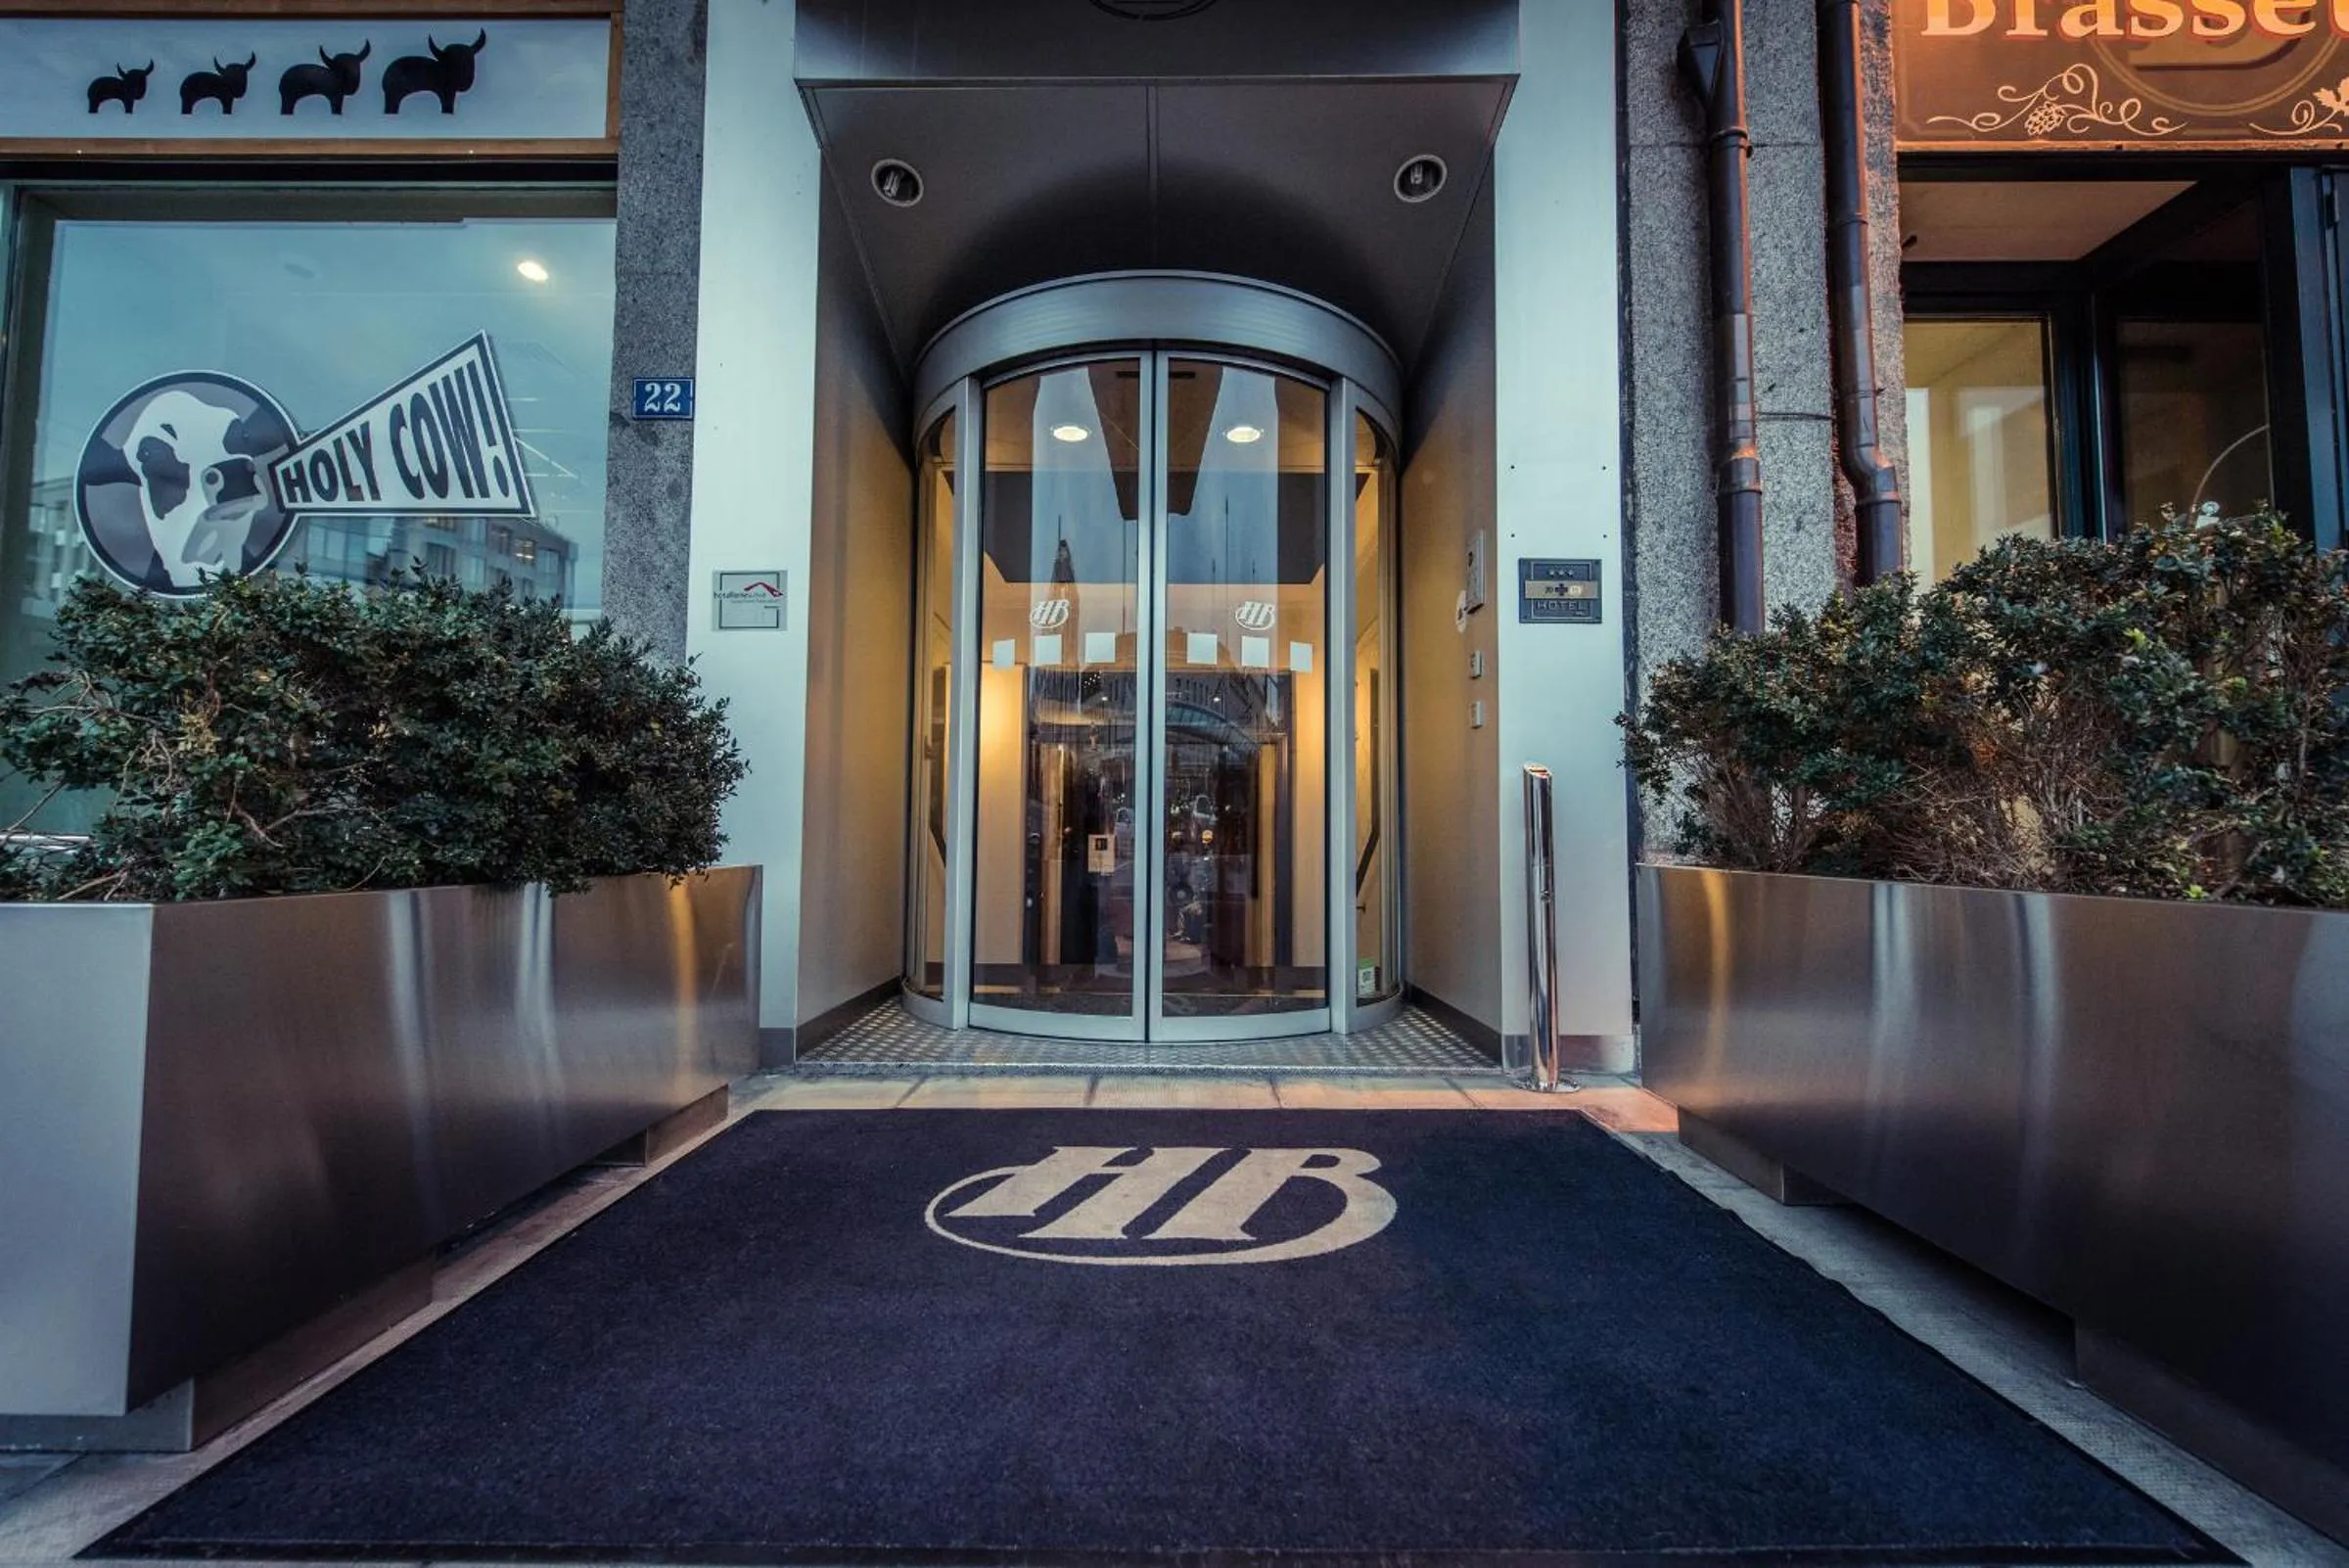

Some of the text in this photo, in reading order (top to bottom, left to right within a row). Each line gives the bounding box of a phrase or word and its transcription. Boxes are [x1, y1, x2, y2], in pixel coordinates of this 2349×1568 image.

[1921, 0, 2349, 38] Brasse
[644, 382, 681, 412] 22
[281, 359, 510, 503] HOLY COW!
[1537, 600, 1588, 611] HOTEL
[924, 1146, 1398, 1265] HB
